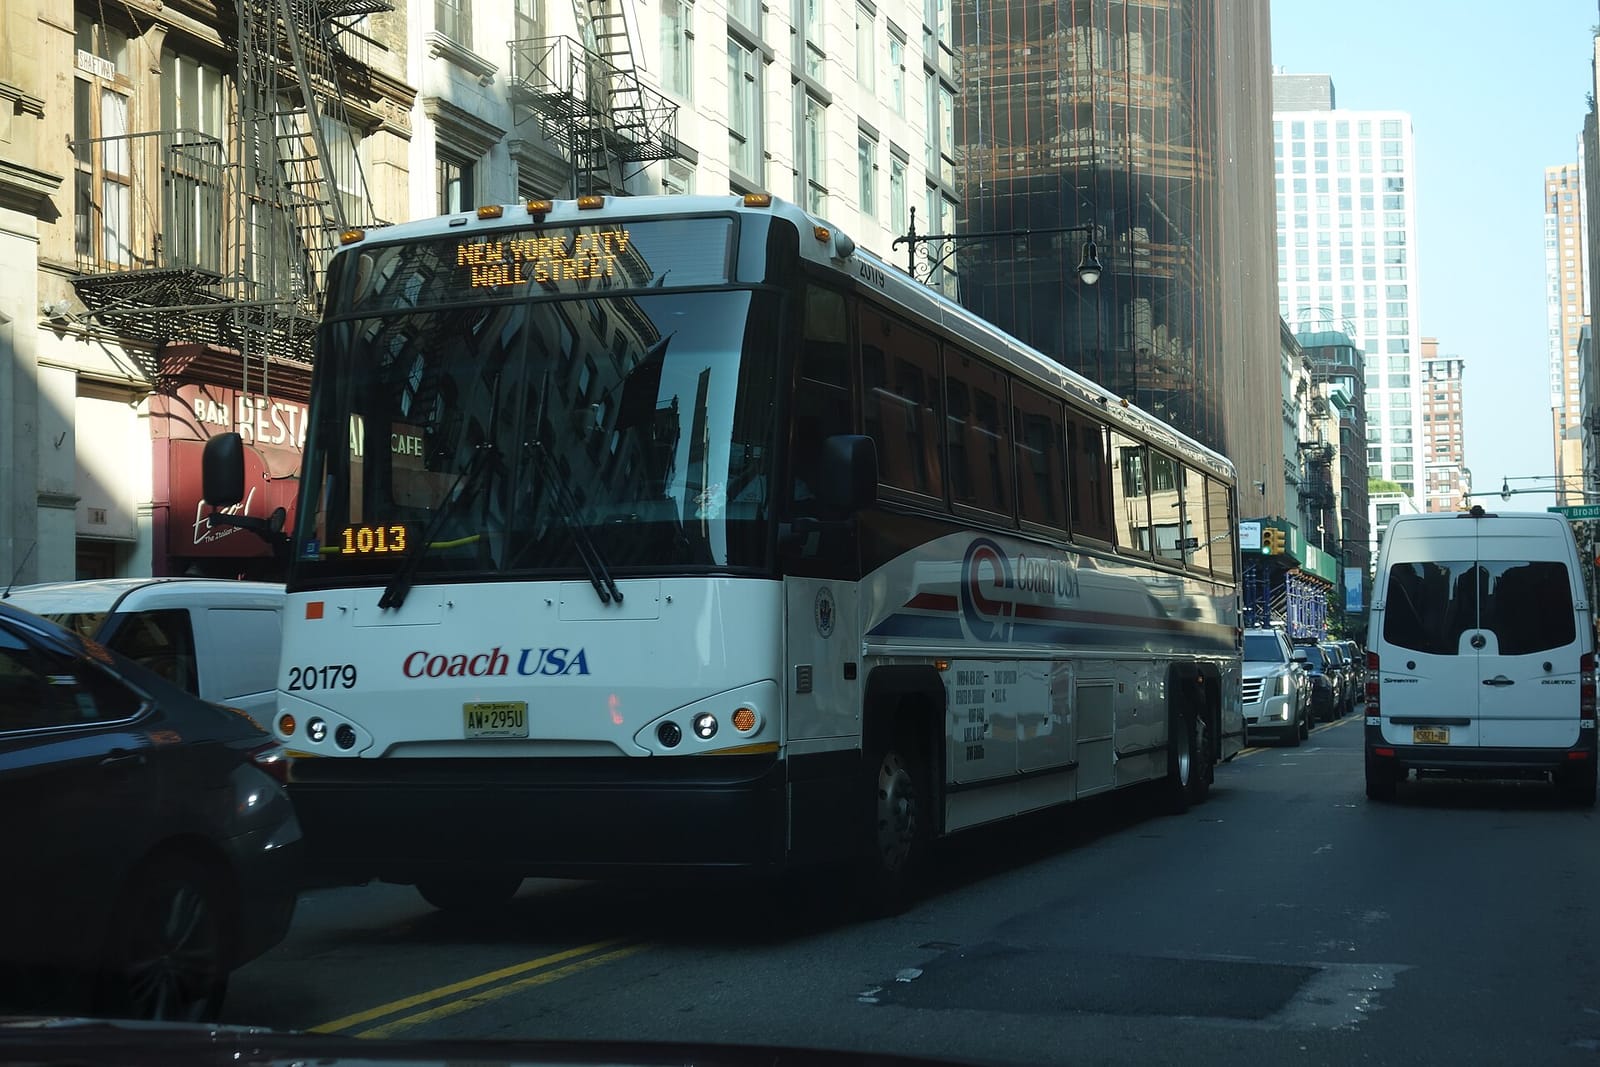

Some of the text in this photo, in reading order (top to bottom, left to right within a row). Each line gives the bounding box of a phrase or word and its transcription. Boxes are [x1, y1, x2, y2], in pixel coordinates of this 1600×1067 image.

[456, 230, 630, 266] NEW YORK CITY
[471, 255, 616, 288] WALL STREET
[194, 398, 230, 426] BAR
[390, 432, 423, 456] CAFE
[341, 525, 406, 554] 1013
[1017, 553, 1080, 599] Coach USA
[289, 664, 358, 691] 20179
[403, 646, 591, 678] Coach USA
